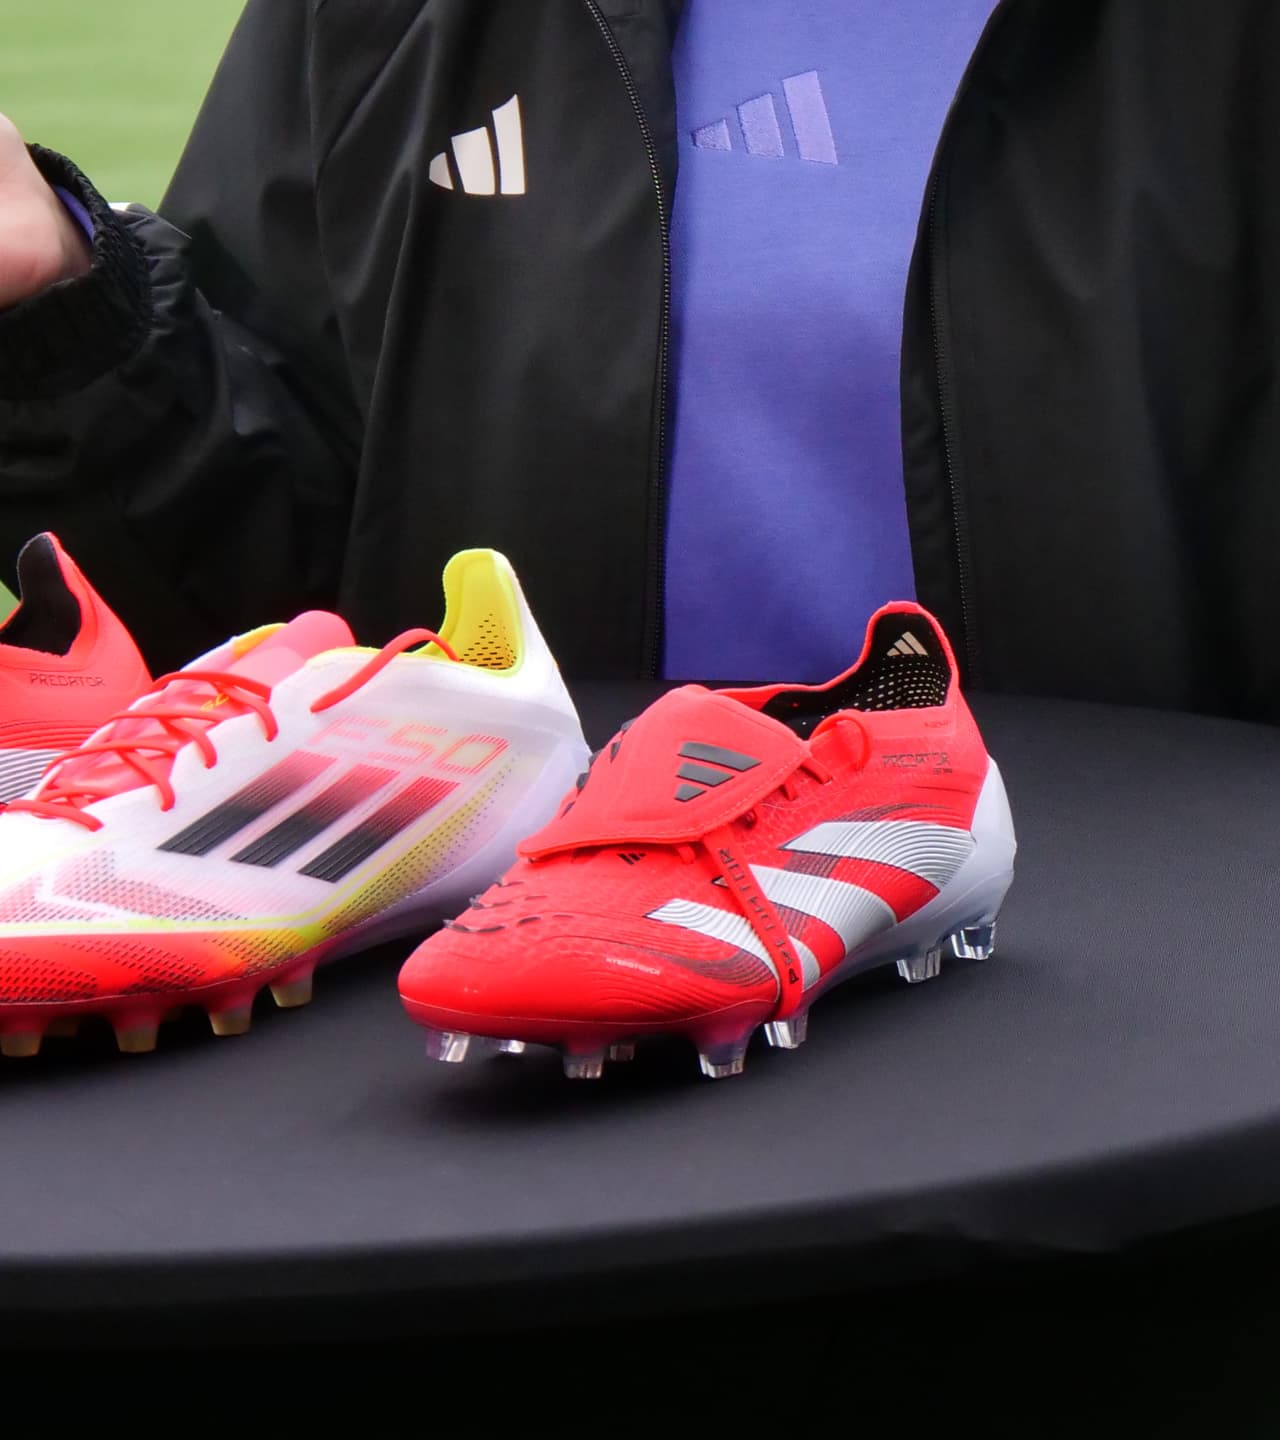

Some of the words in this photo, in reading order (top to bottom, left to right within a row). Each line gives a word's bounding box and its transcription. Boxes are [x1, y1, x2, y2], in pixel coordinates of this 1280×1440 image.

[29, 672, 106, 688] PREDATOR
[306, 716, 509, 775] F50
[718, 847, 799, 984] PREDATOR
